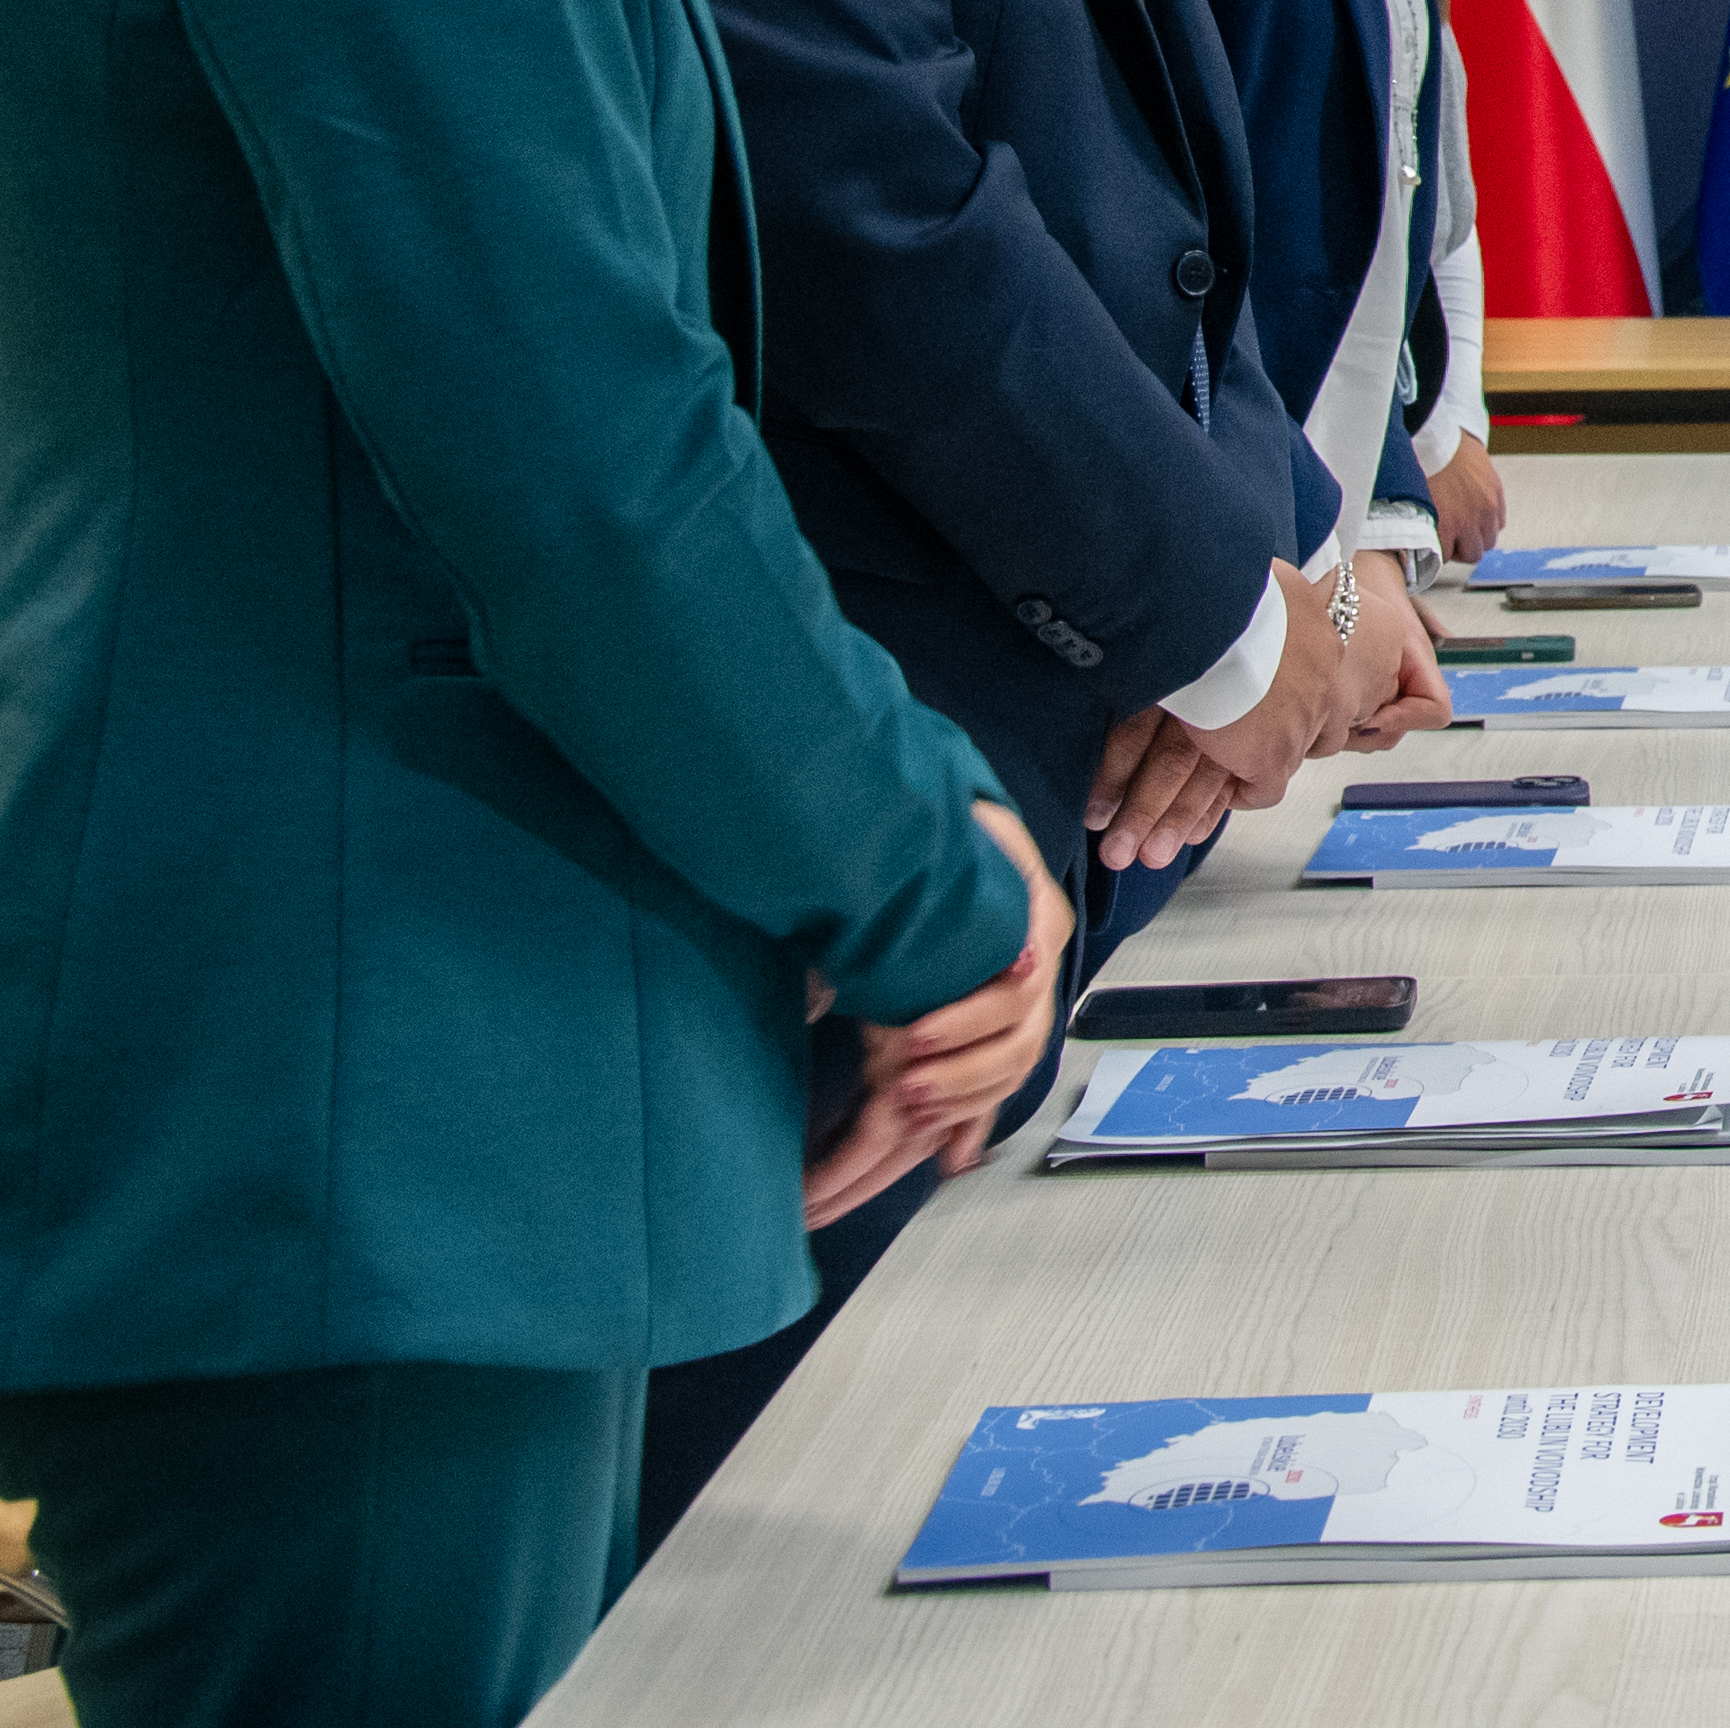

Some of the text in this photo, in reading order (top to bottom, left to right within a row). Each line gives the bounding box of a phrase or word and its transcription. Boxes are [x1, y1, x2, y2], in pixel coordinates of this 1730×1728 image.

[1496, 1416, 1530, 1439] 2030
[1525, 1392, 1579, 1512] THE LUBLIN VOIVODSHIP
[1580, 1392, 1622, 1460] STRATEGY FOR
[1625, 1391, 1665, 1464] DEVELOPMENT
